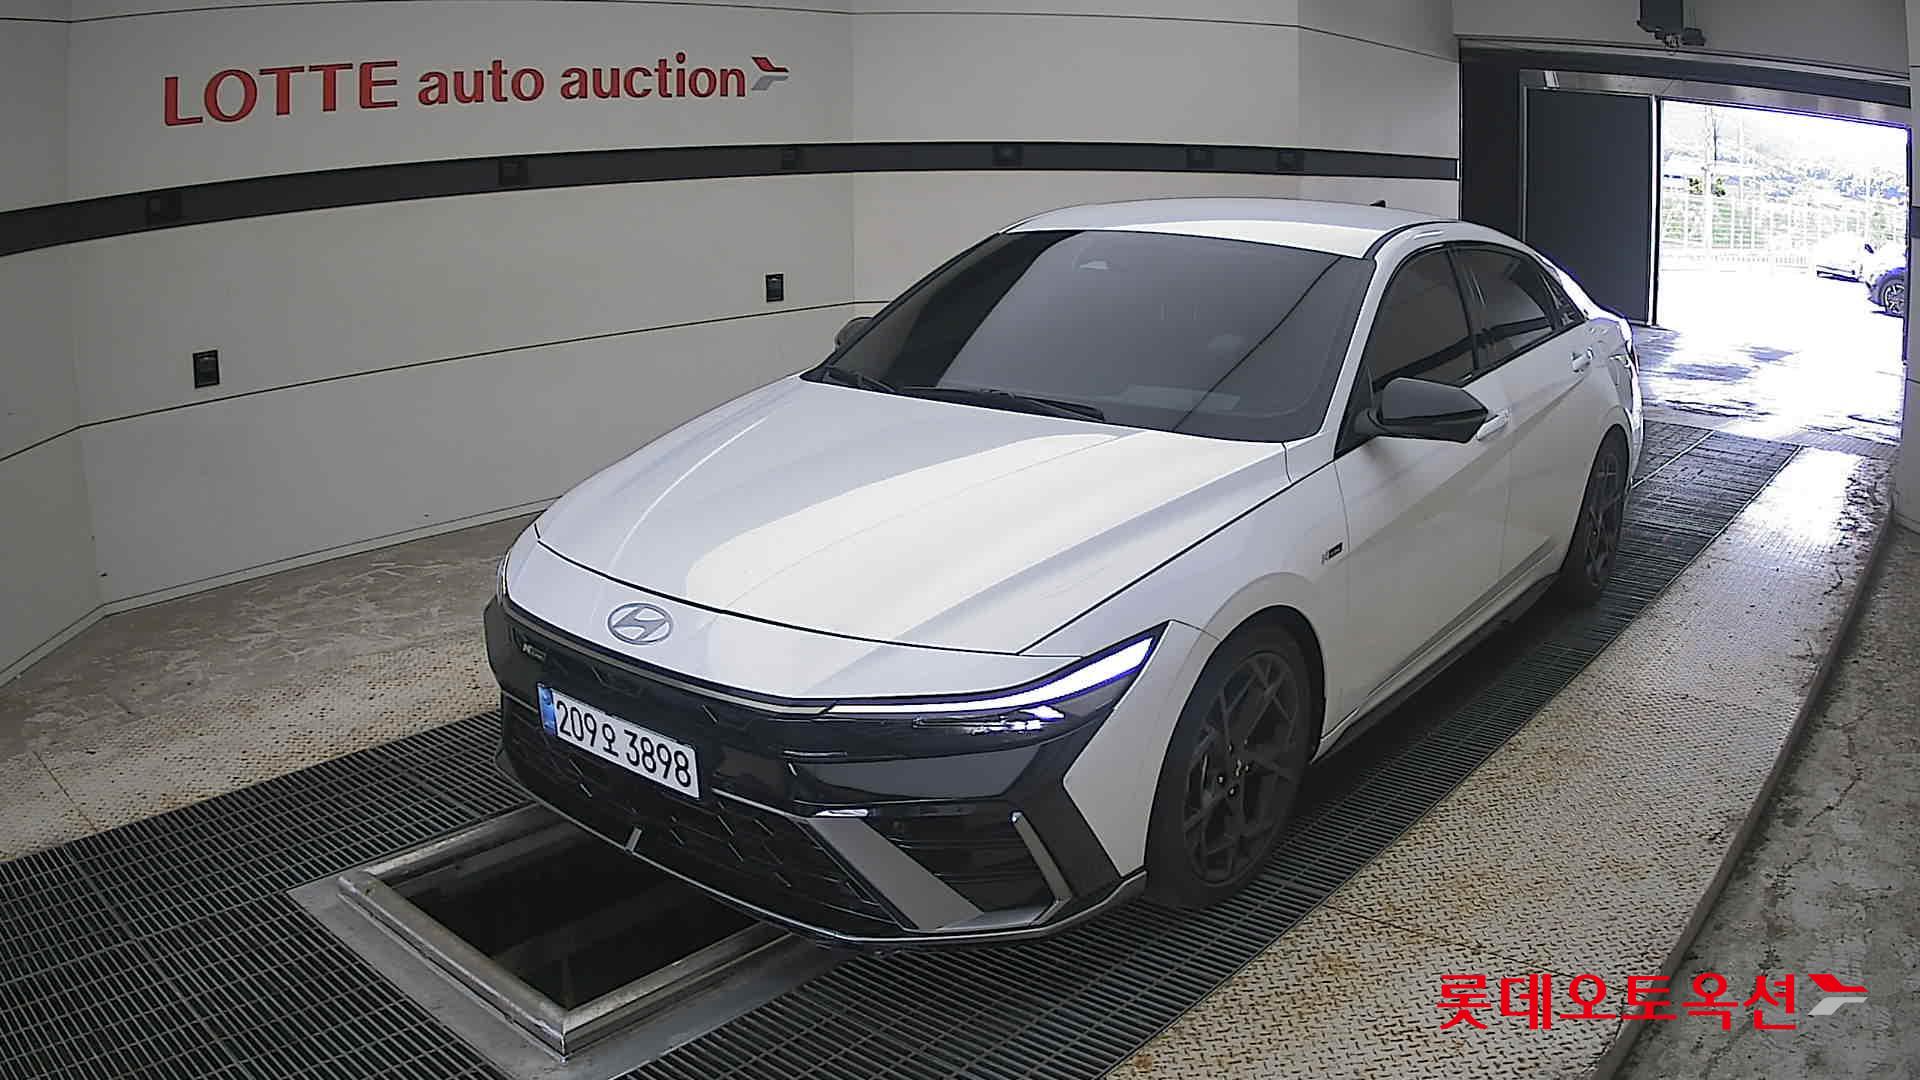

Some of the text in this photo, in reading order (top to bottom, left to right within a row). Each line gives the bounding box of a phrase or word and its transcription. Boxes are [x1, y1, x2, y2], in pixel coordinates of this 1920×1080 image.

[164, 52, 746, 126] LOTTE auto auction
